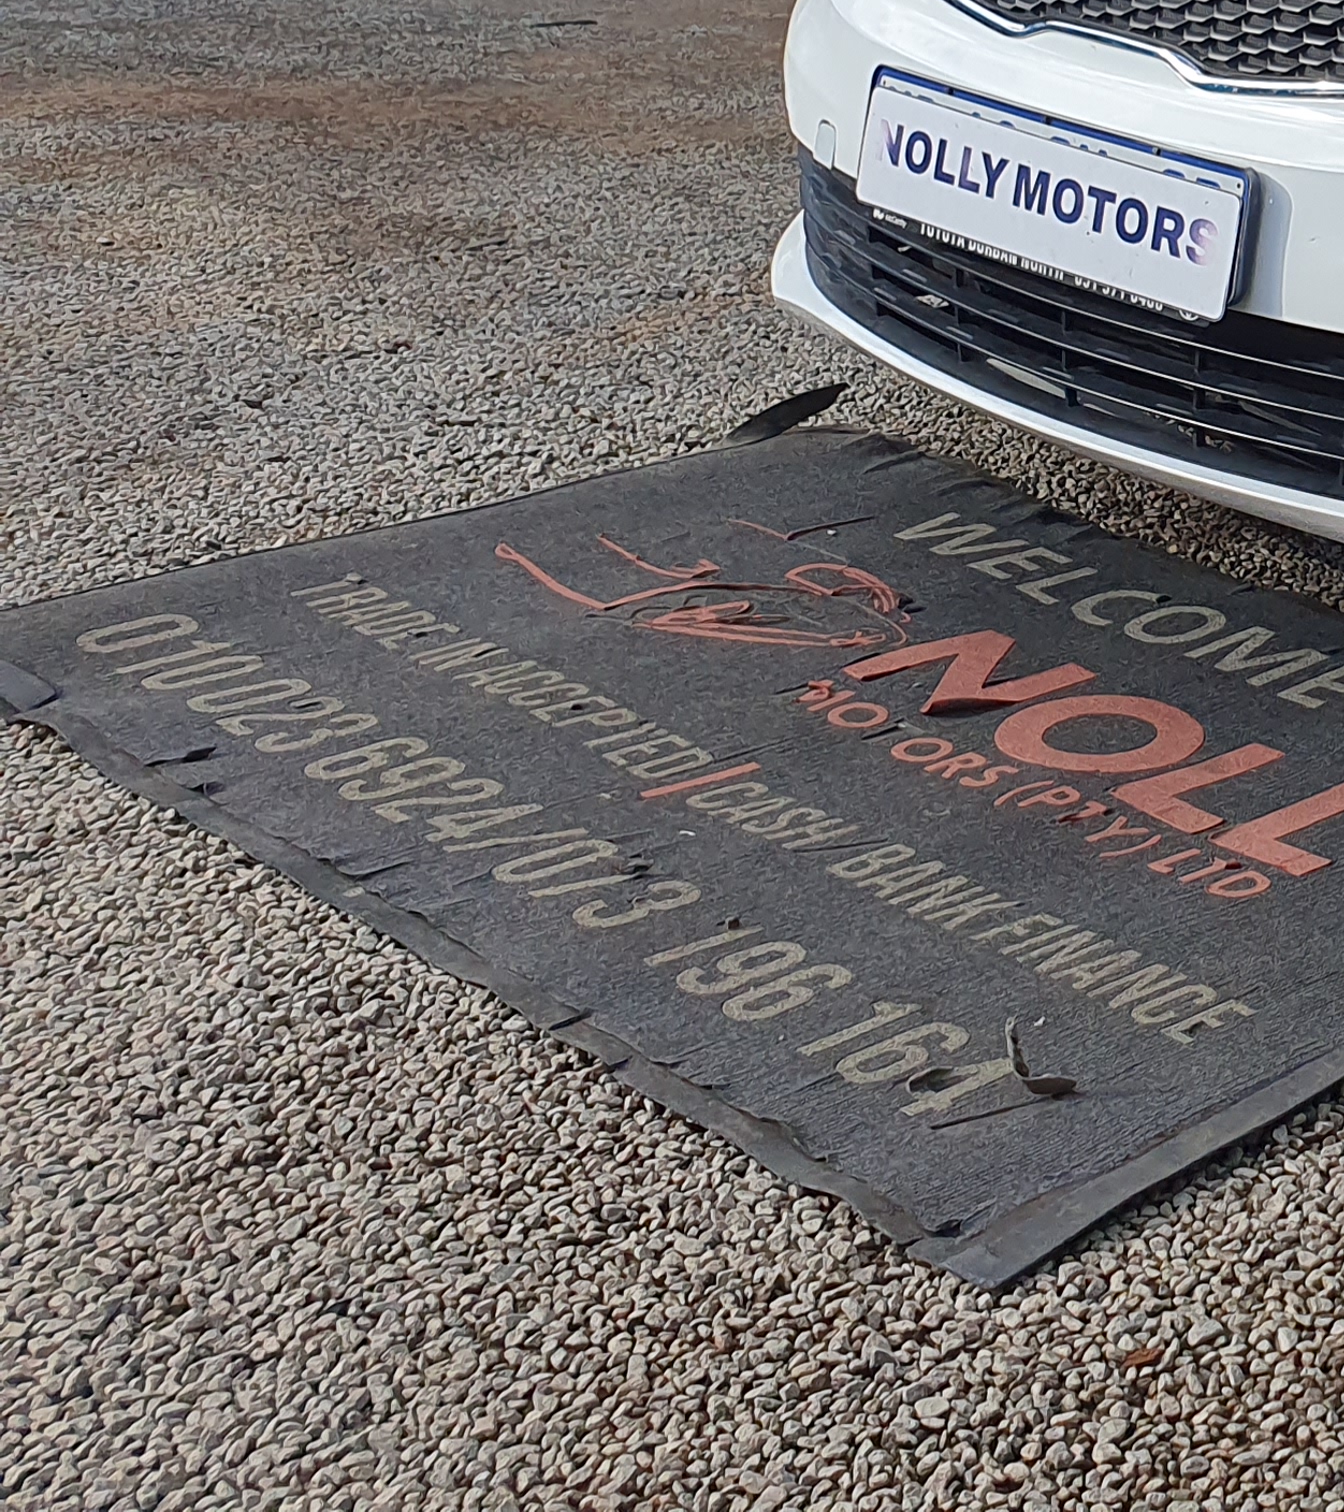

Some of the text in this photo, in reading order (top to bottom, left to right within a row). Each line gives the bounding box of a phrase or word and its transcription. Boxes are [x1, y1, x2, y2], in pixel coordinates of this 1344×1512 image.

[879, 118, 1220, 267] NOLLY MOTORS
[74, 613, 266, 690] 010
[184, 677, 379, 754] 023
[290, 571, 461, 652] TRADE
[970, 911, 1258, 1045] FINANCE
[993, 778, 1162, 859] (PTY)
[1146, 847, 1273, 899] LTD
